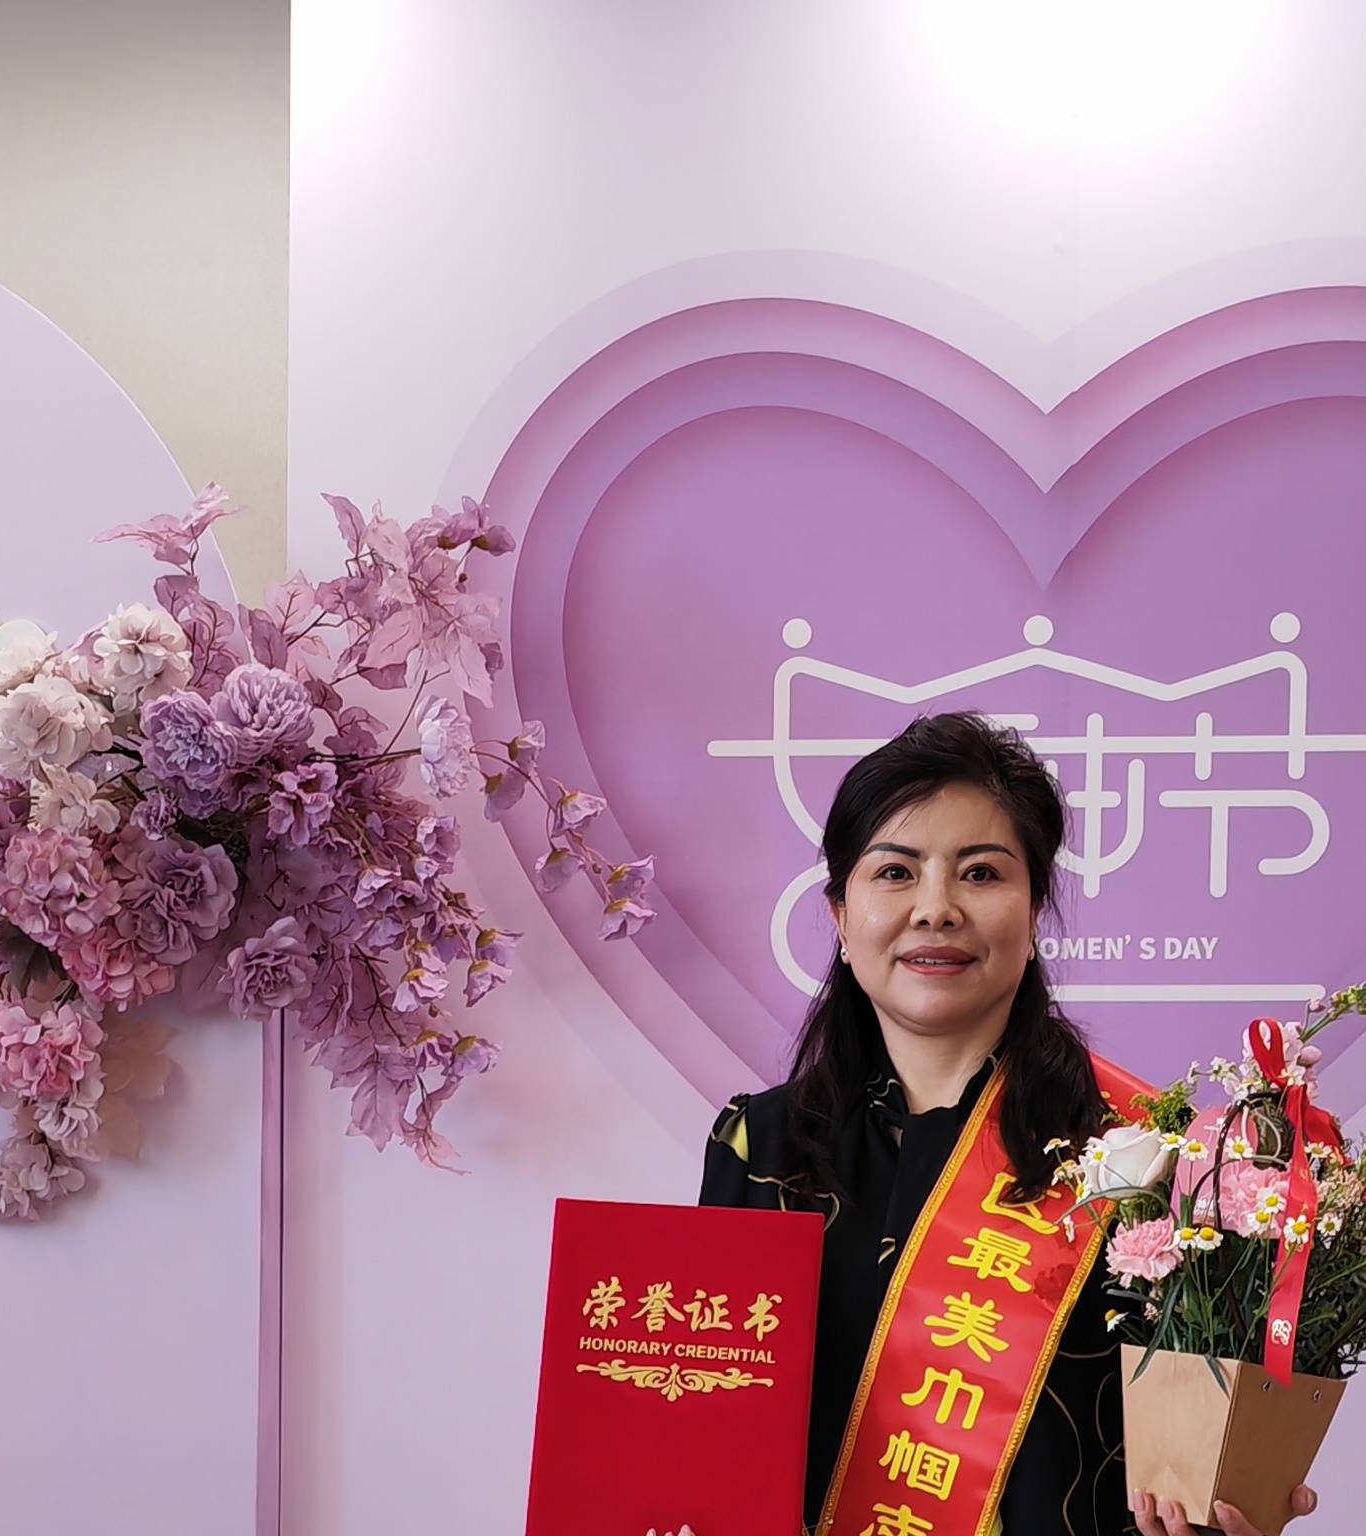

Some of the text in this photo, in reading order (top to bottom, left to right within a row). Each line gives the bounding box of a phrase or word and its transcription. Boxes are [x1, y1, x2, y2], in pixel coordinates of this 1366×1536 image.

[1163, 936, 1219, 960] DAY
[581, 1276, 783, 1342] 荣誉证书
[579, 1337, 776, 1364] HONORARY CREDENTIAL
